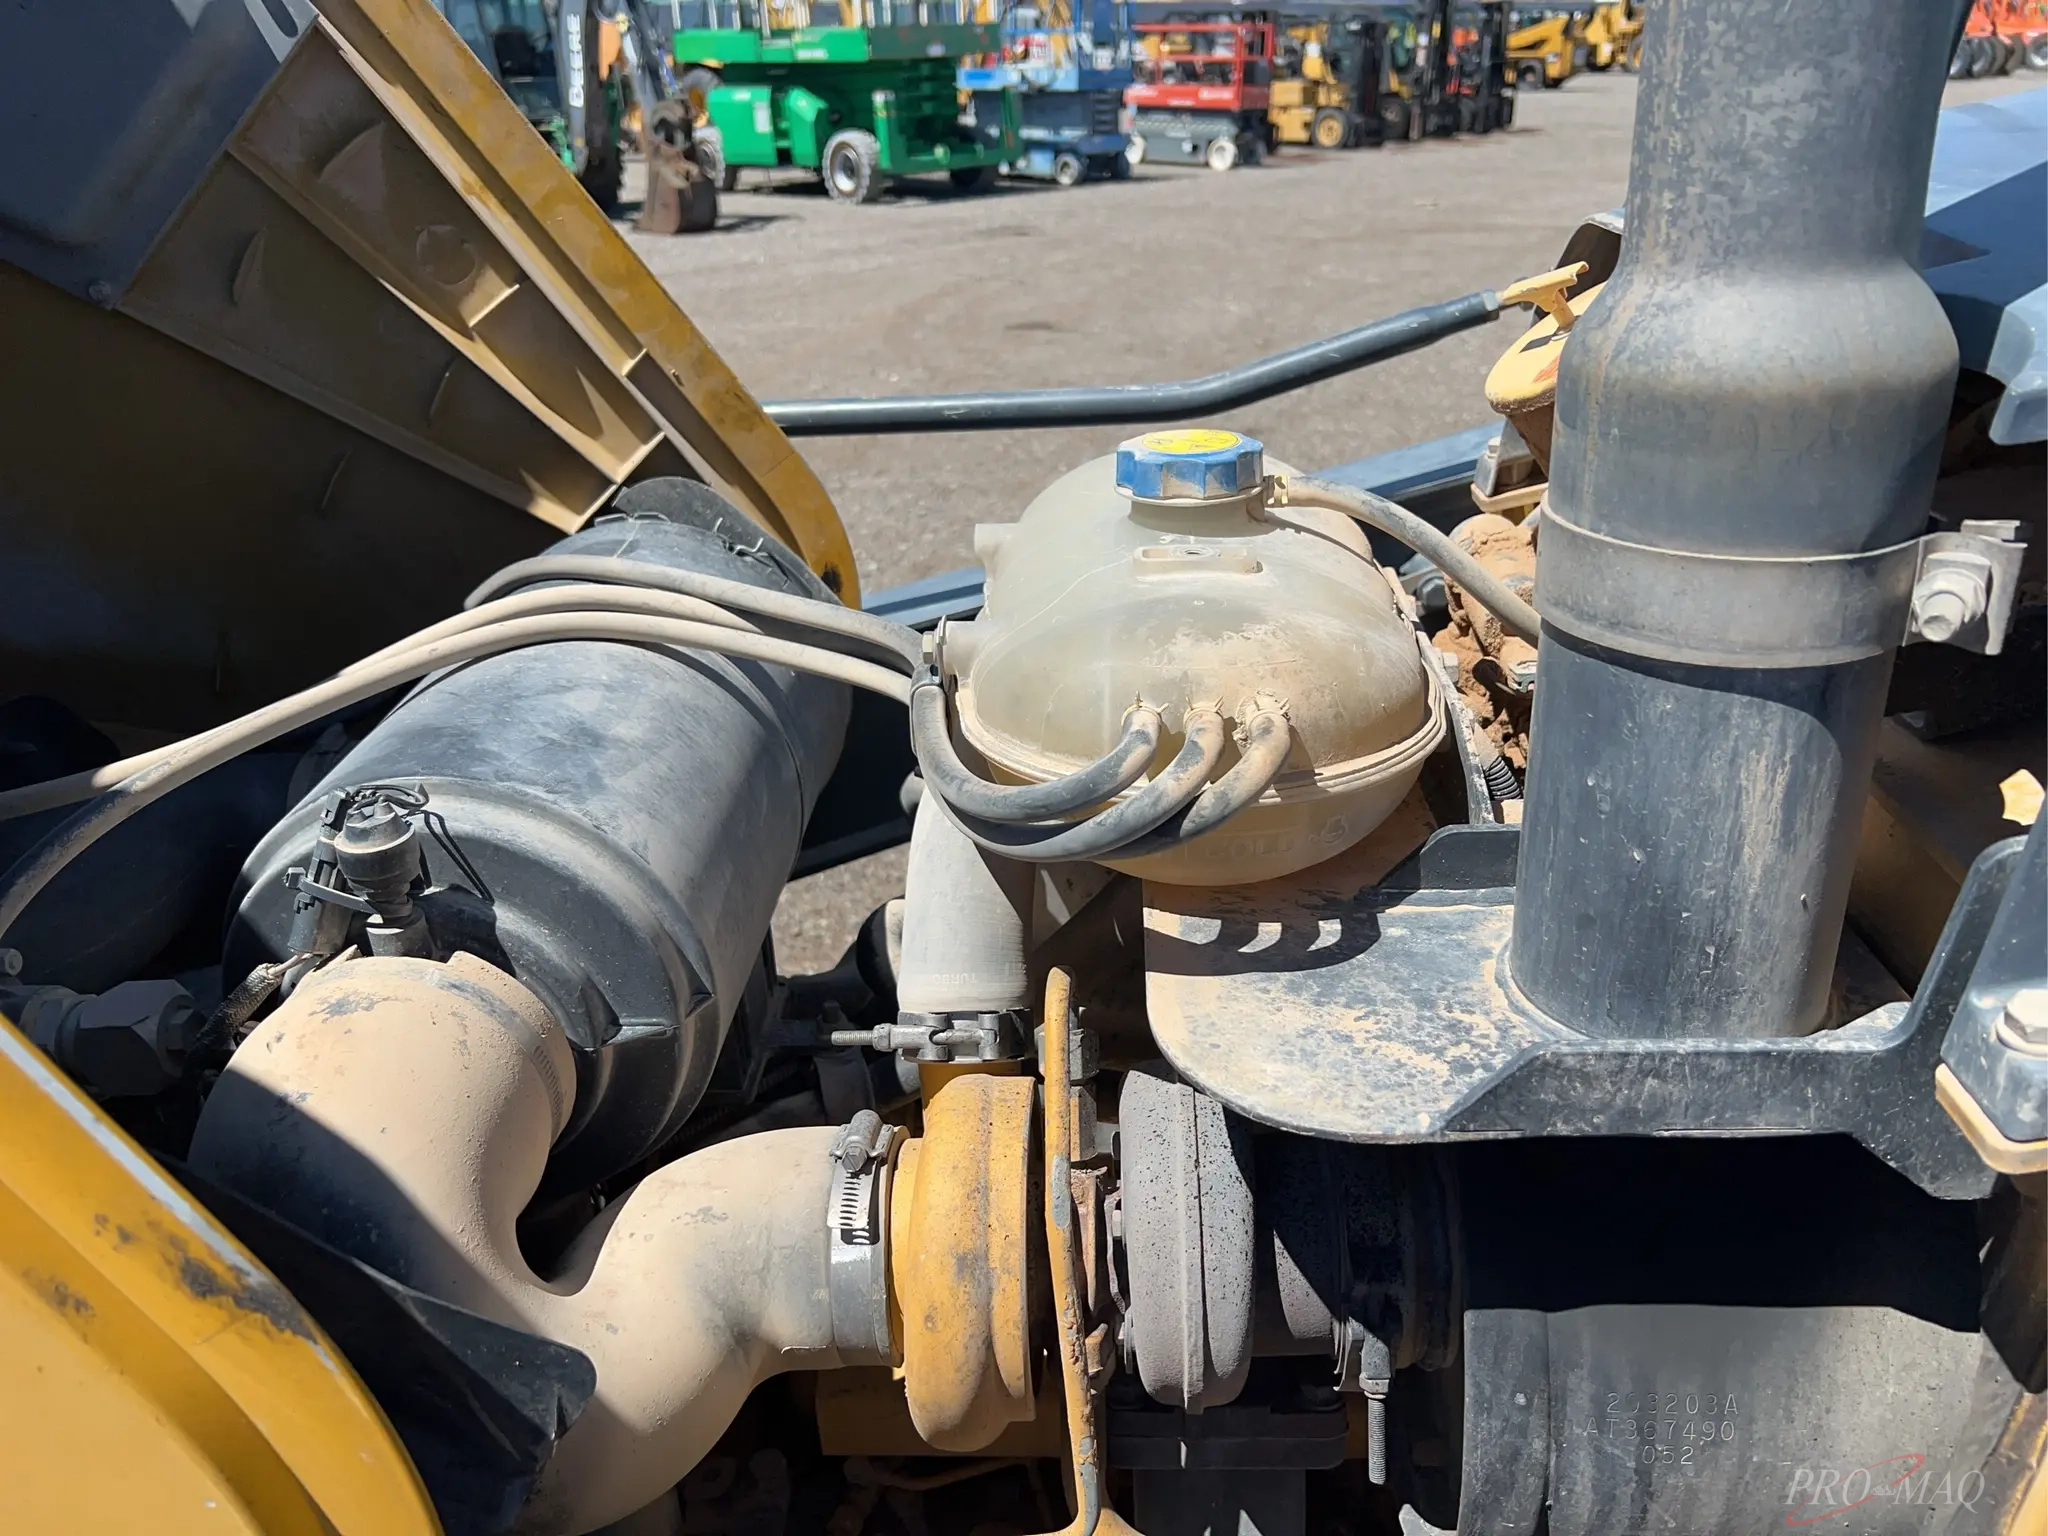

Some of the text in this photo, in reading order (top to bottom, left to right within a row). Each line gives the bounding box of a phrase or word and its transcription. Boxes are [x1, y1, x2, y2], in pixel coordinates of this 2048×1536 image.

[566, 12, 584, 108] DEERE
[932, 972, 979, 985] TURBO
[1582, 1416, 1735, 1441] AT367490
[1642, 1445, 1694, 1465] 052
